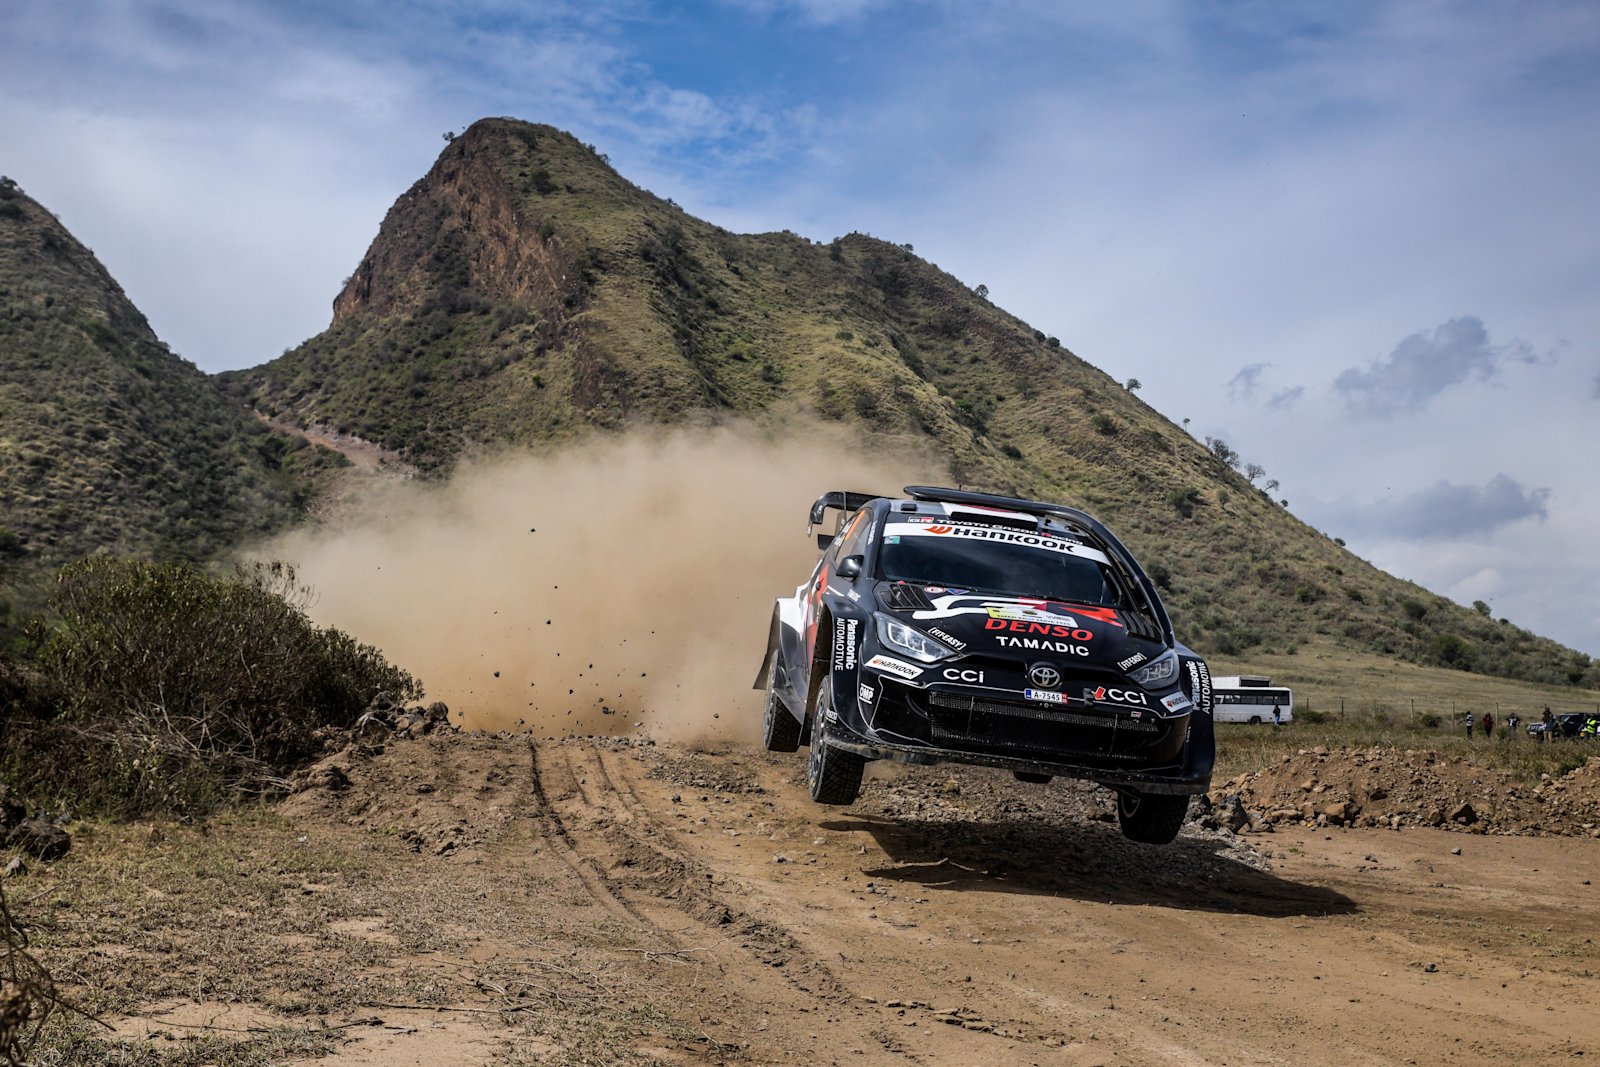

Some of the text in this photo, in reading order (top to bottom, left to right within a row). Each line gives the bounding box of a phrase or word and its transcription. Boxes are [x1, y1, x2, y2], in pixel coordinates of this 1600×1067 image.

[937, 519, 989, 528] TOYOTA
[985, 618, 1093, 641] DENSO
[834, 617, 846, 671] AUTOMOTIVE
[845, 618, 859, 670] Panasonic
[996, 636, 1089, 657] TAMADIC
[860, 686, 874, 700] OMP
[1034, 691, 1060, 701] A-7545
[1186, 660, 1201, 711] Panasonic
[1197, 661, 1211, 714] AUTOMOTIVE
